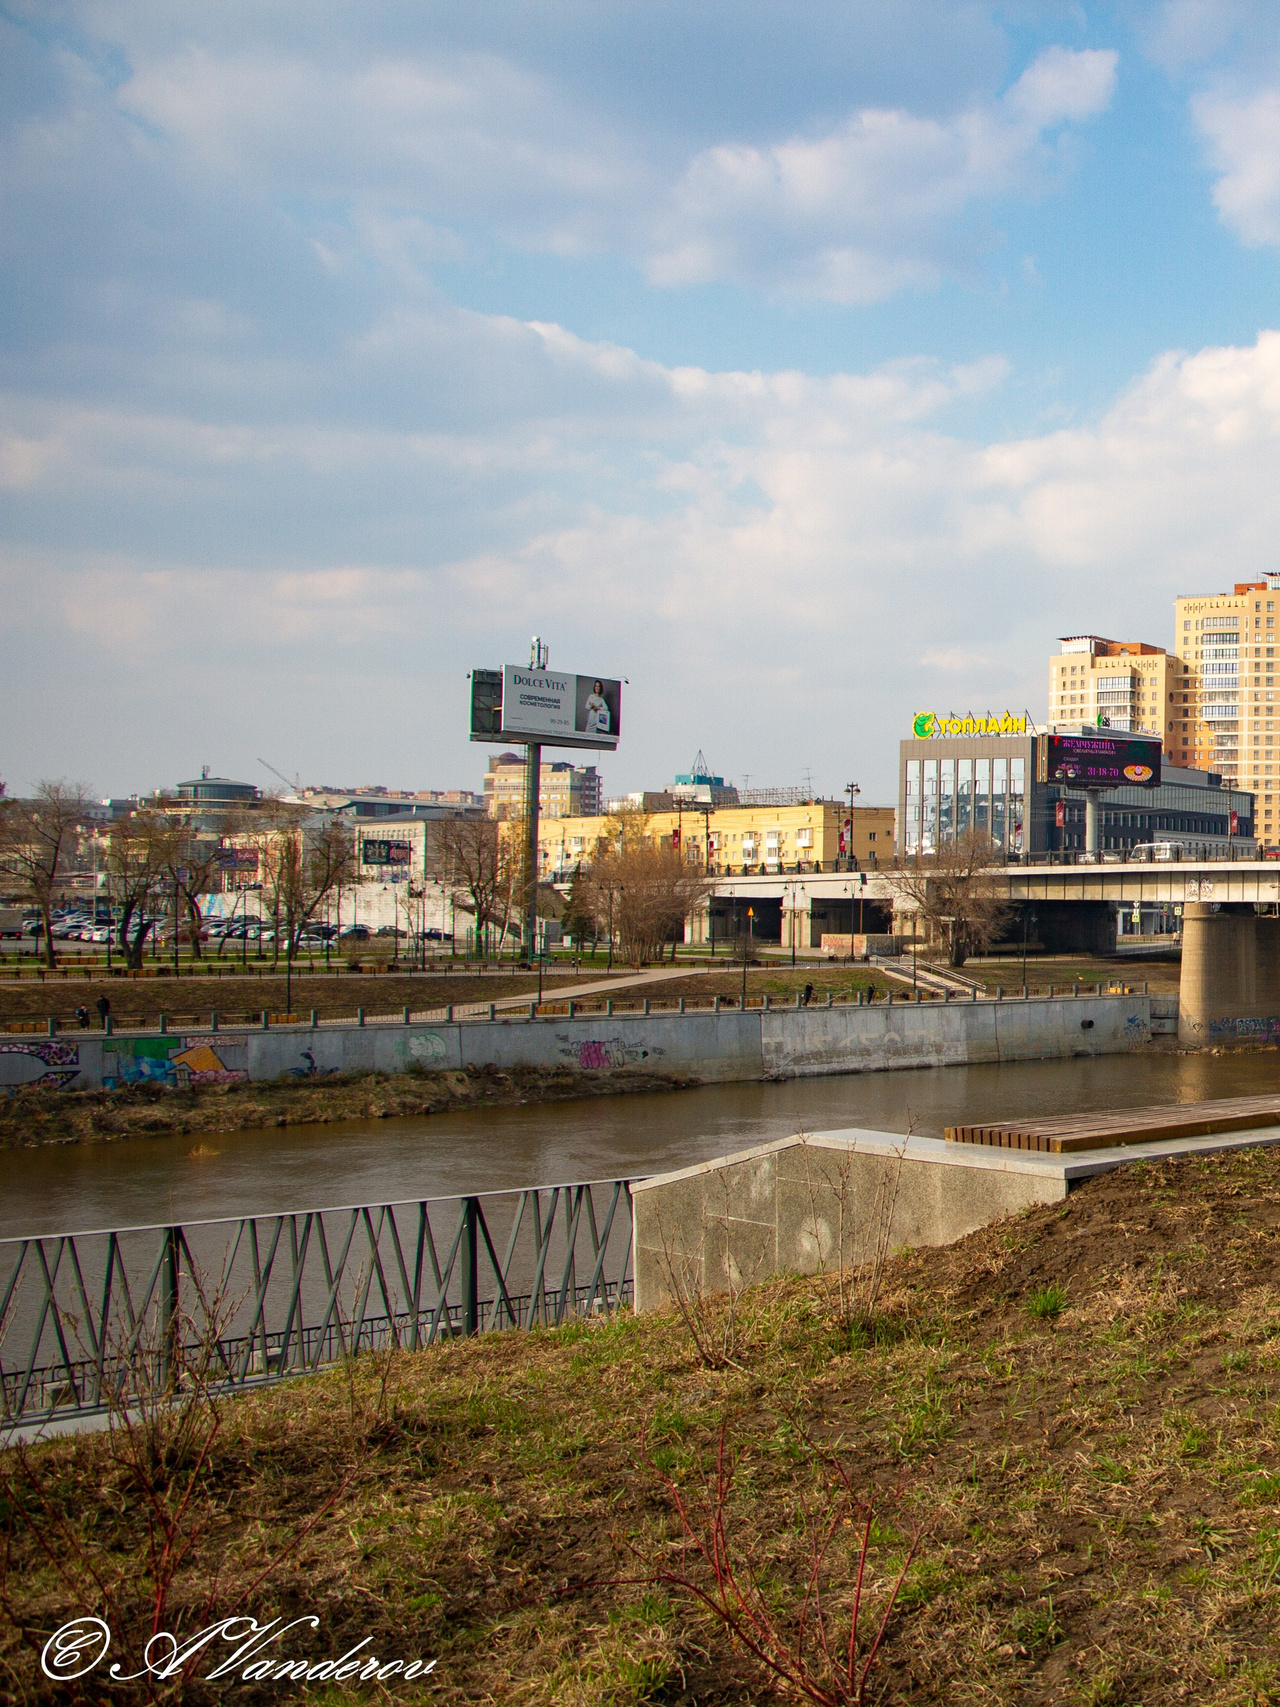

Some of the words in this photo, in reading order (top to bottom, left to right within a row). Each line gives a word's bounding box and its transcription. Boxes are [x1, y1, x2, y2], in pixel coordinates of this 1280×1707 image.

[520, 694, 561, 703] СОВРЕМЕННАЯ
[519, 700, 561, 710] КОСМЕТОЛОГИЯ
[938, 712, 1026, 734] ТОПЛАЙН
[1062, 739, 1116, 750] ЖЕМЧУЖИНА
[1088, 767, 1118, 776] 31-18-70
